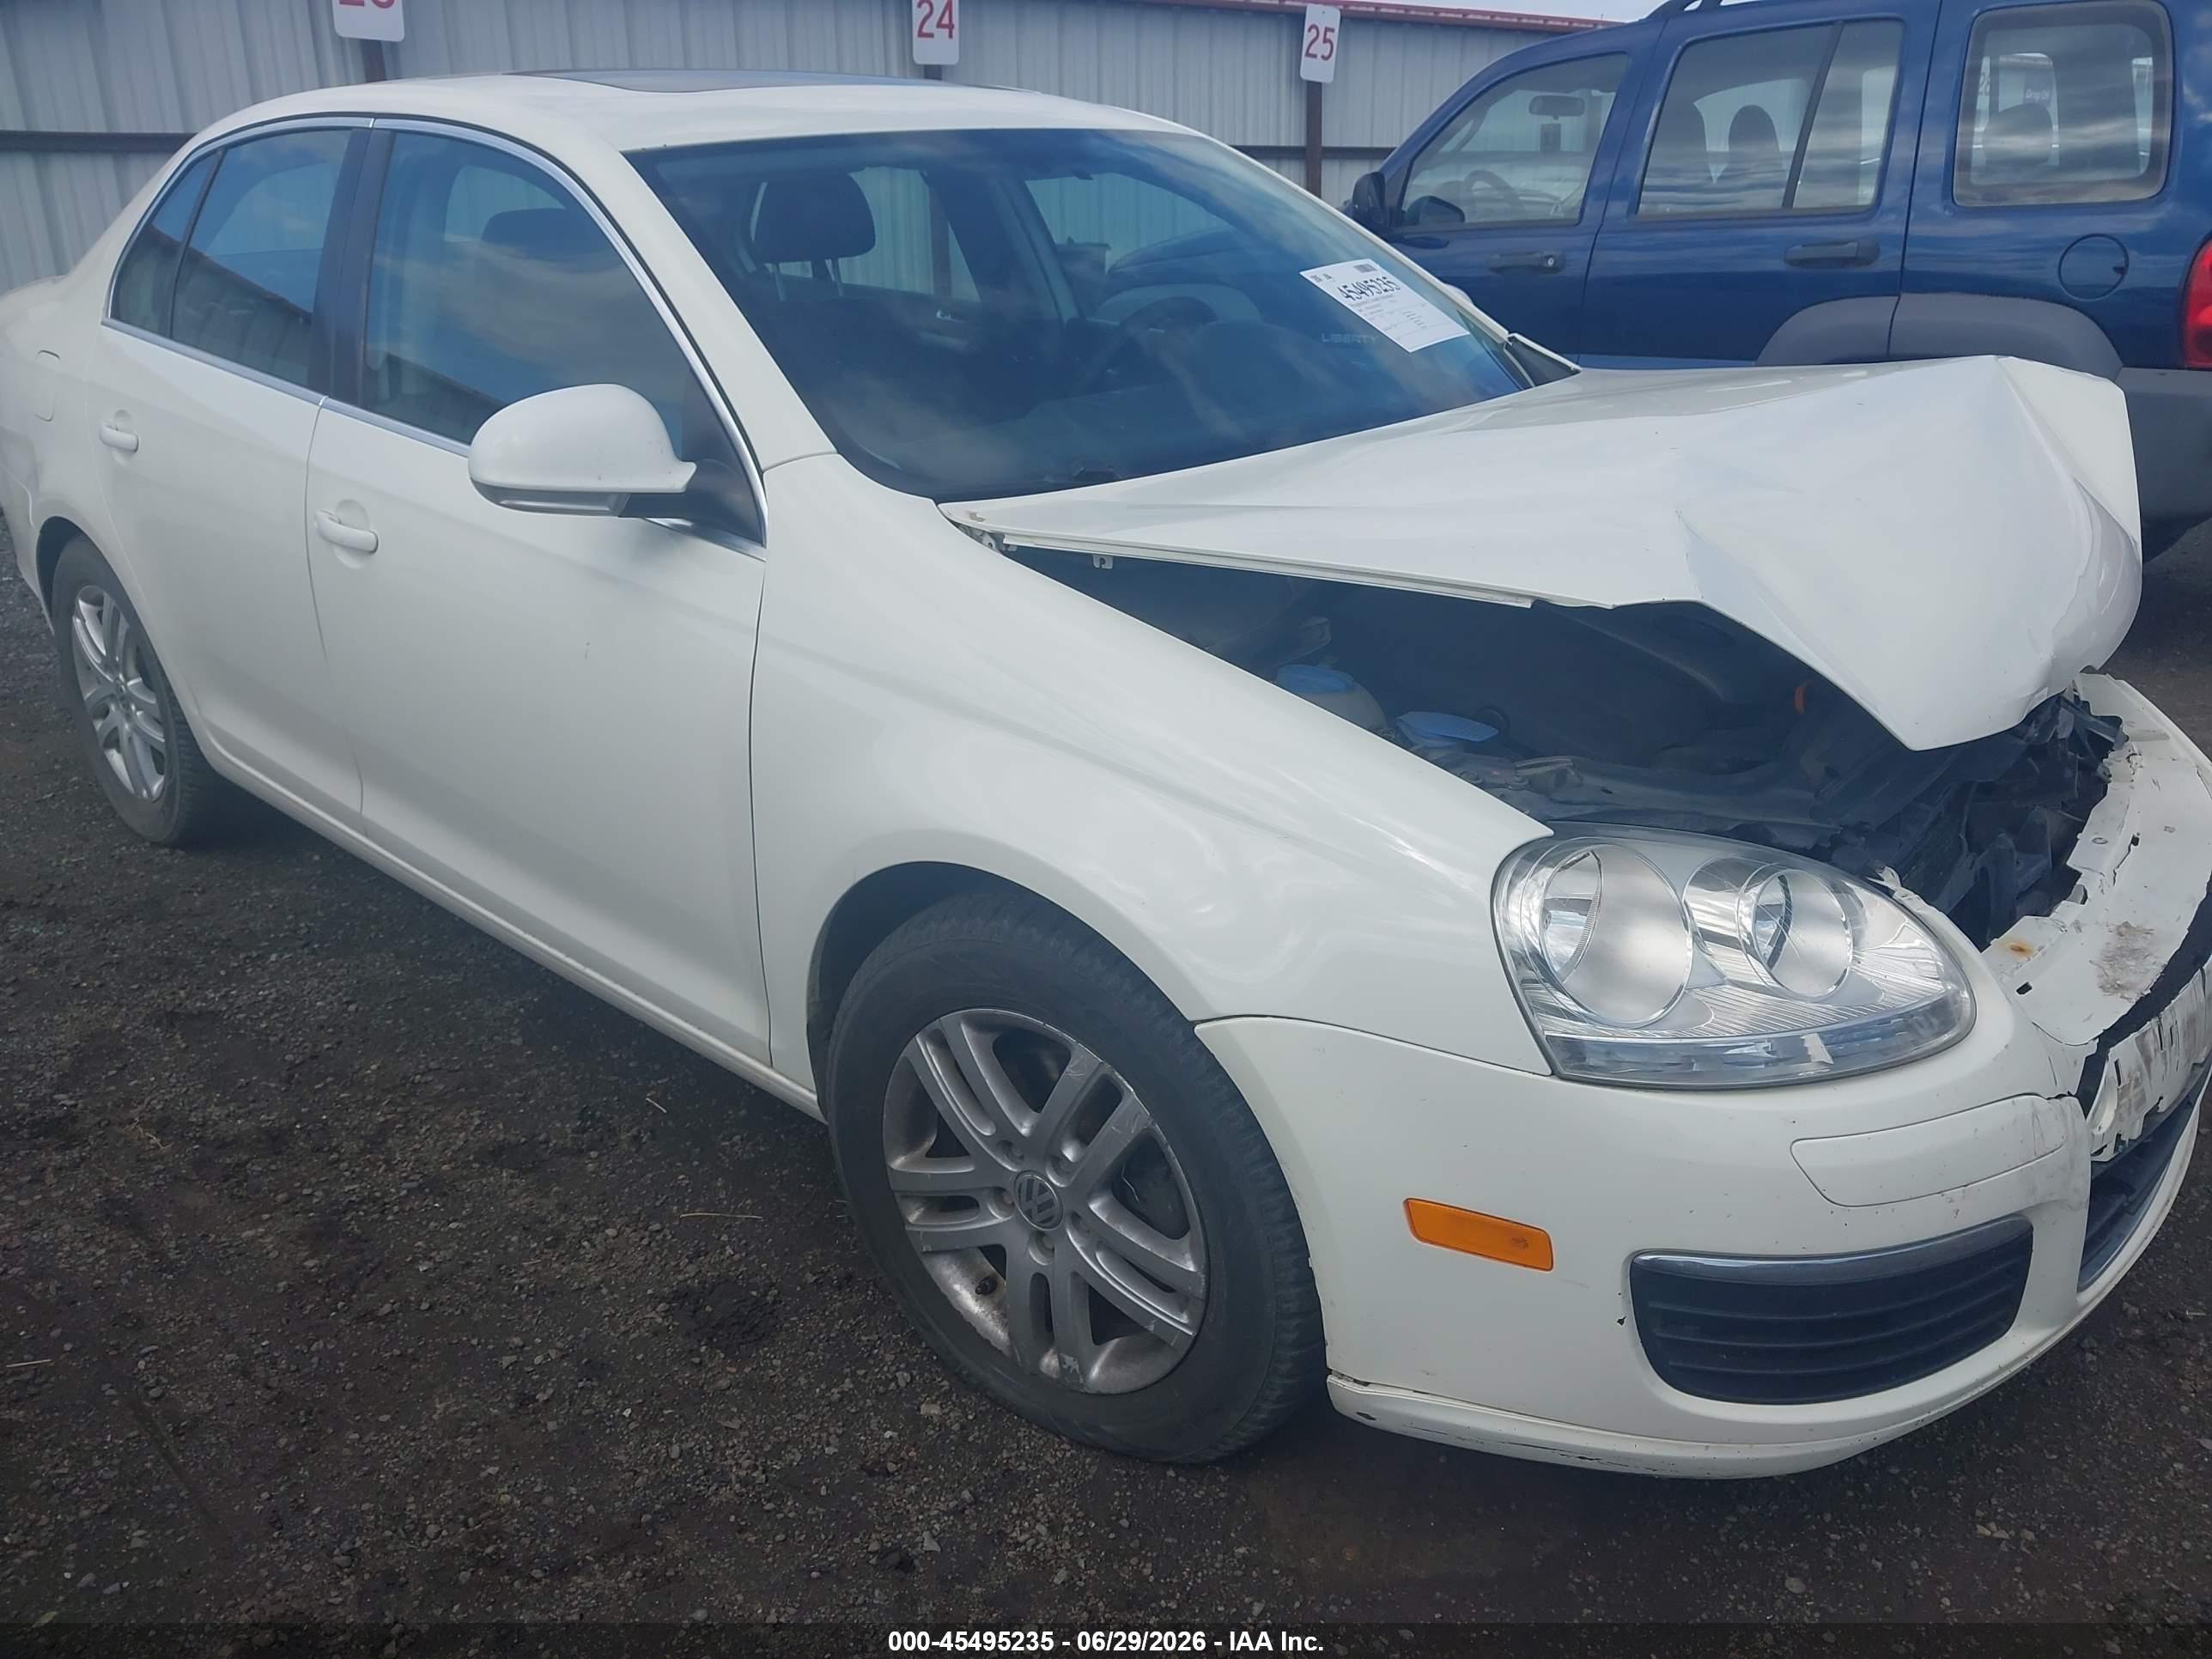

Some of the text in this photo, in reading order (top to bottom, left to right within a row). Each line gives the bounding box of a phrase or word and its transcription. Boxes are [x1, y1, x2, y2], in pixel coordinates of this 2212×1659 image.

[916, 0, 955, 40] 24
[1304, 24, 1335, 61] 25
[1337, 276, 1401, 301] 45495235
